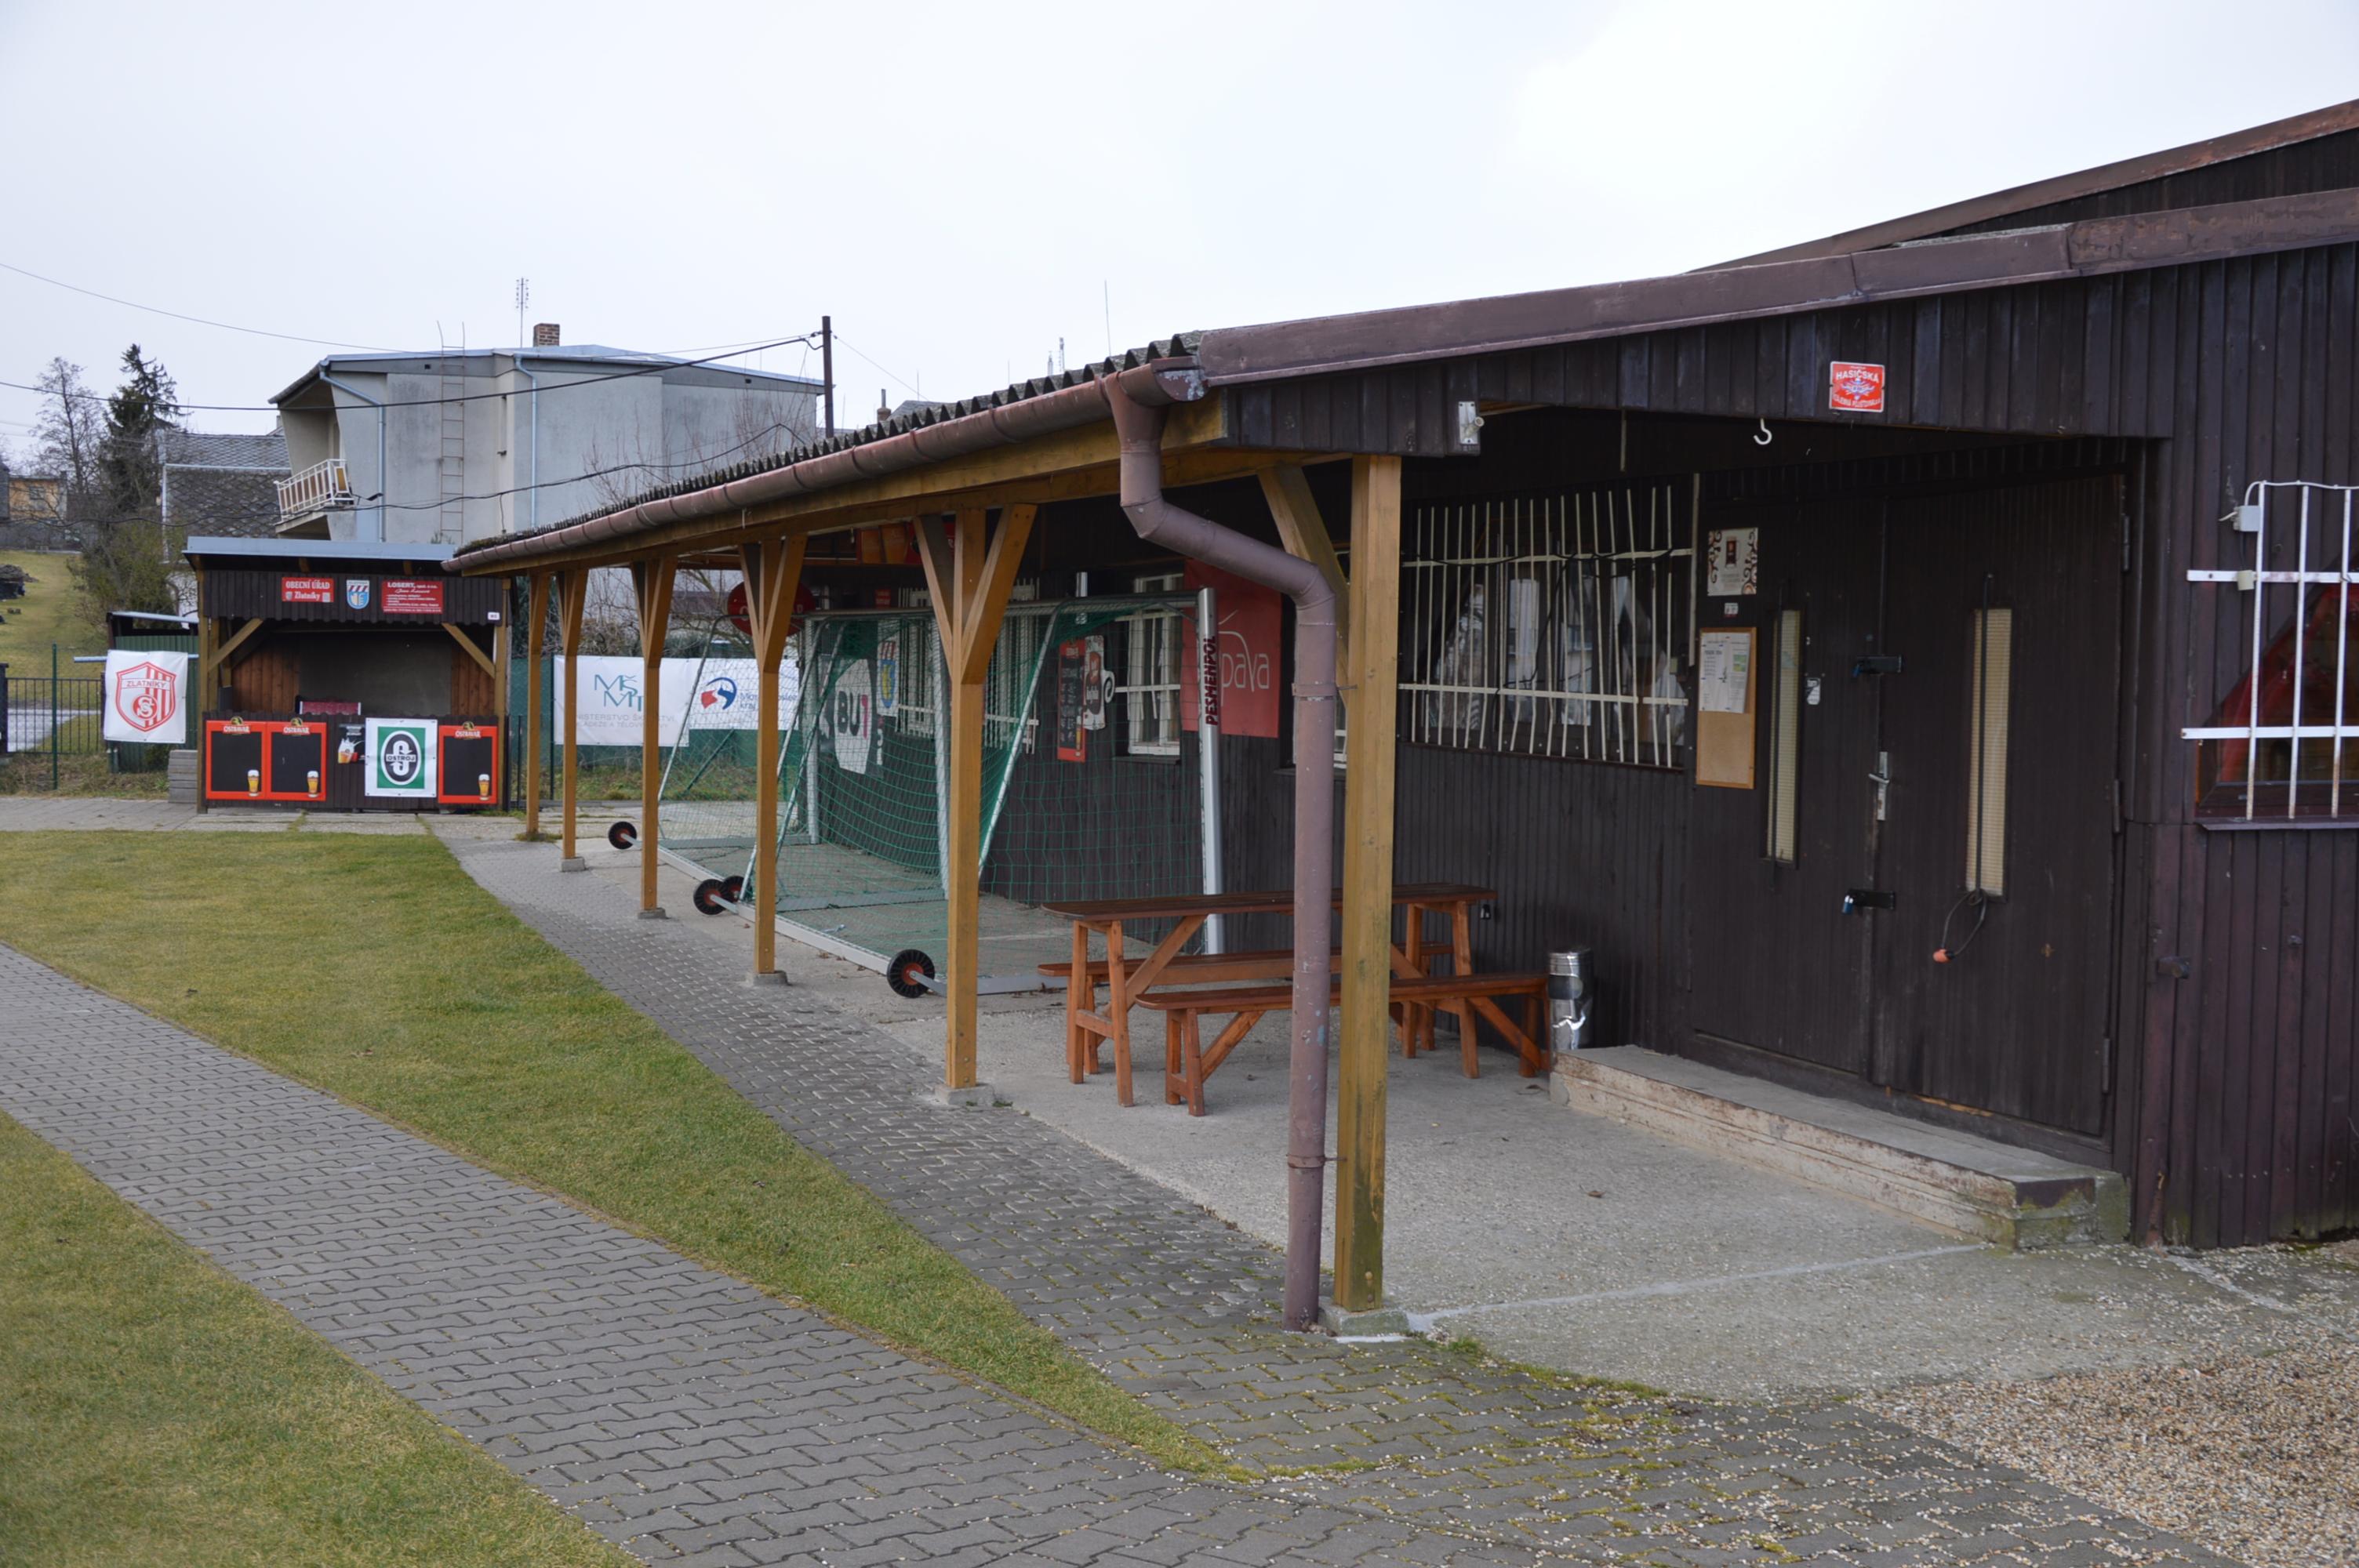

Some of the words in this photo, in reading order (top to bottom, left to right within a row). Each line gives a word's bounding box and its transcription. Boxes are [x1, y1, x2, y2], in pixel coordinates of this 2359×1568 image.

[285, 579, 311, 590] OBECNÍ
[1203, 636, 1219, 726] PESMENPOL
[1218, 652, 1270, 706] pava
[577, 713, 629, 721] NISTERSTVO
